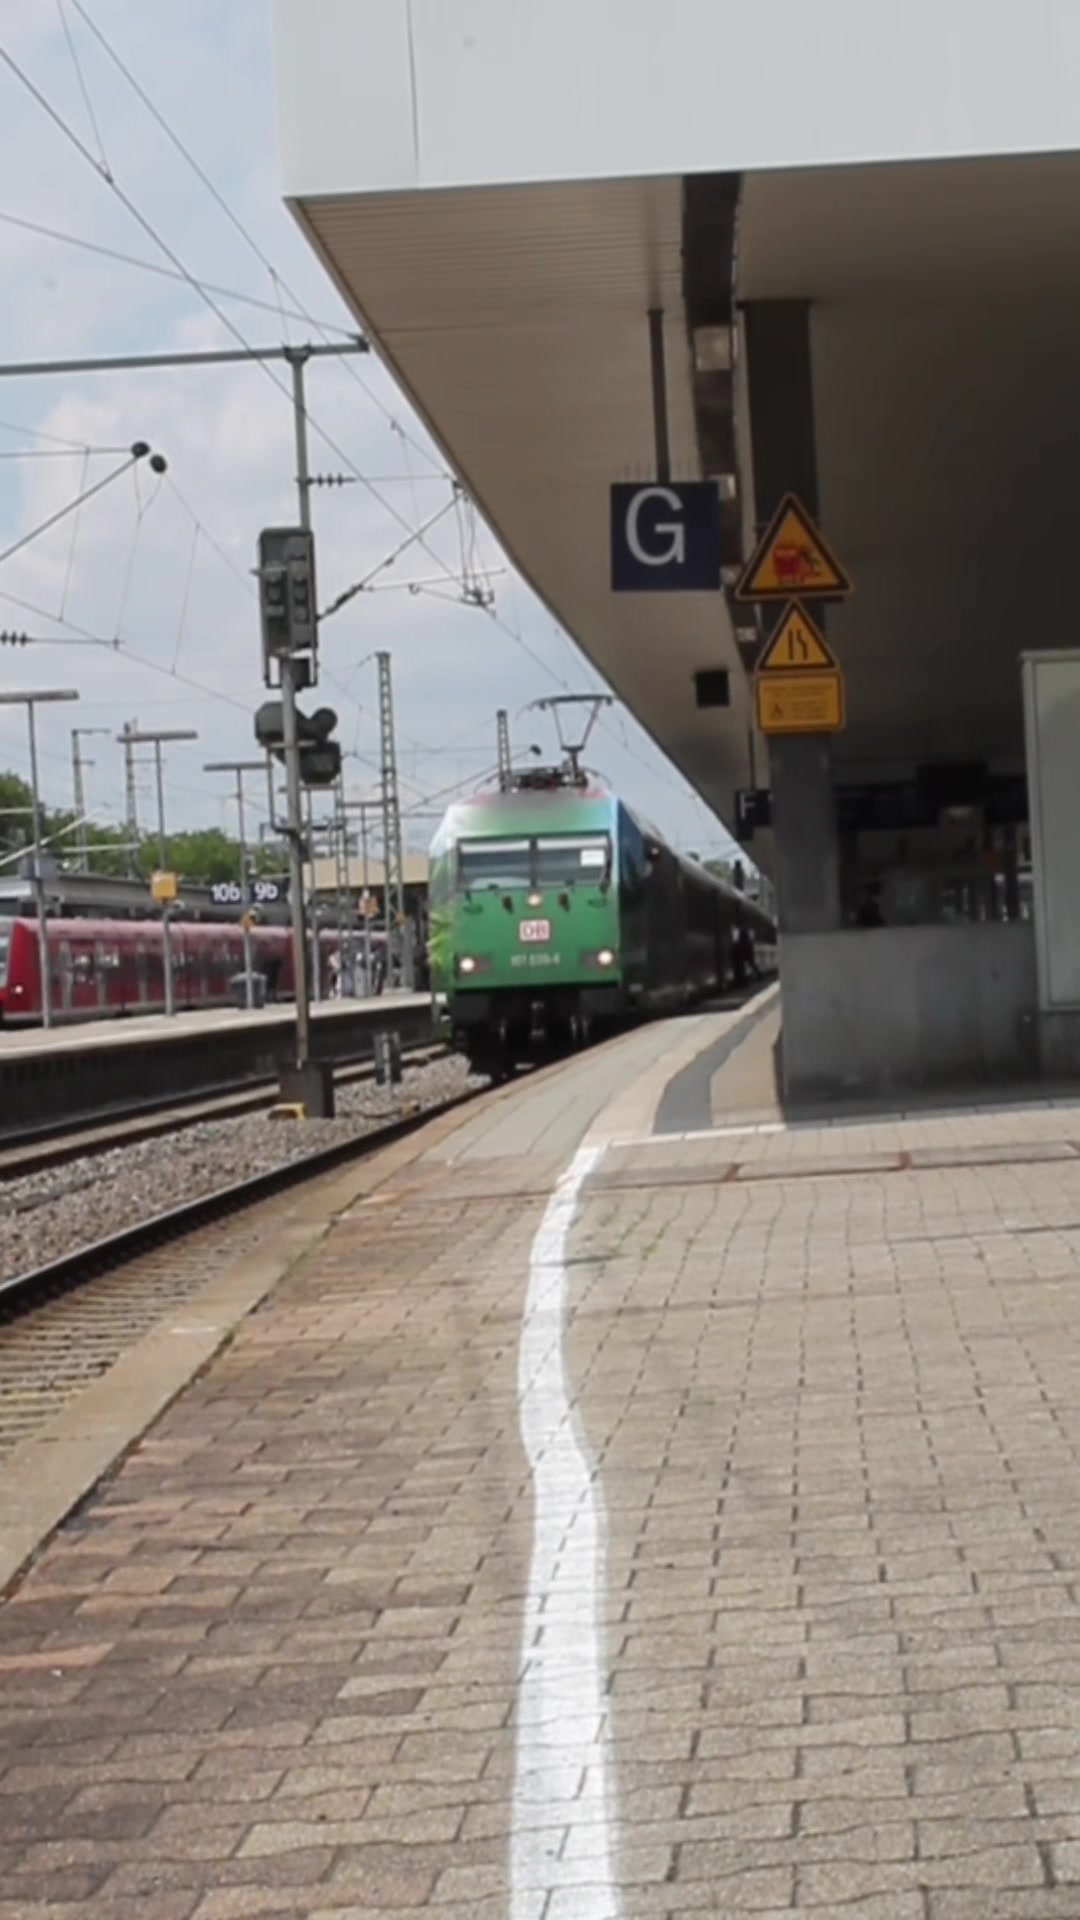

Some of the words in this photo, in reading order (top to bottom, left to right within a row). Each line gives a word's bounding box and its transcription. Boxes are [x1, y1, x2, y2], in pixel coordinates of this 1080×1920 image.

[625, 487, 685, 566] G
[741, 791, 756, 819] F
[211, 881, 241, 902] 10b
[254, 882, 279, 901] 9b
[522, 922, 548, 939] DB
